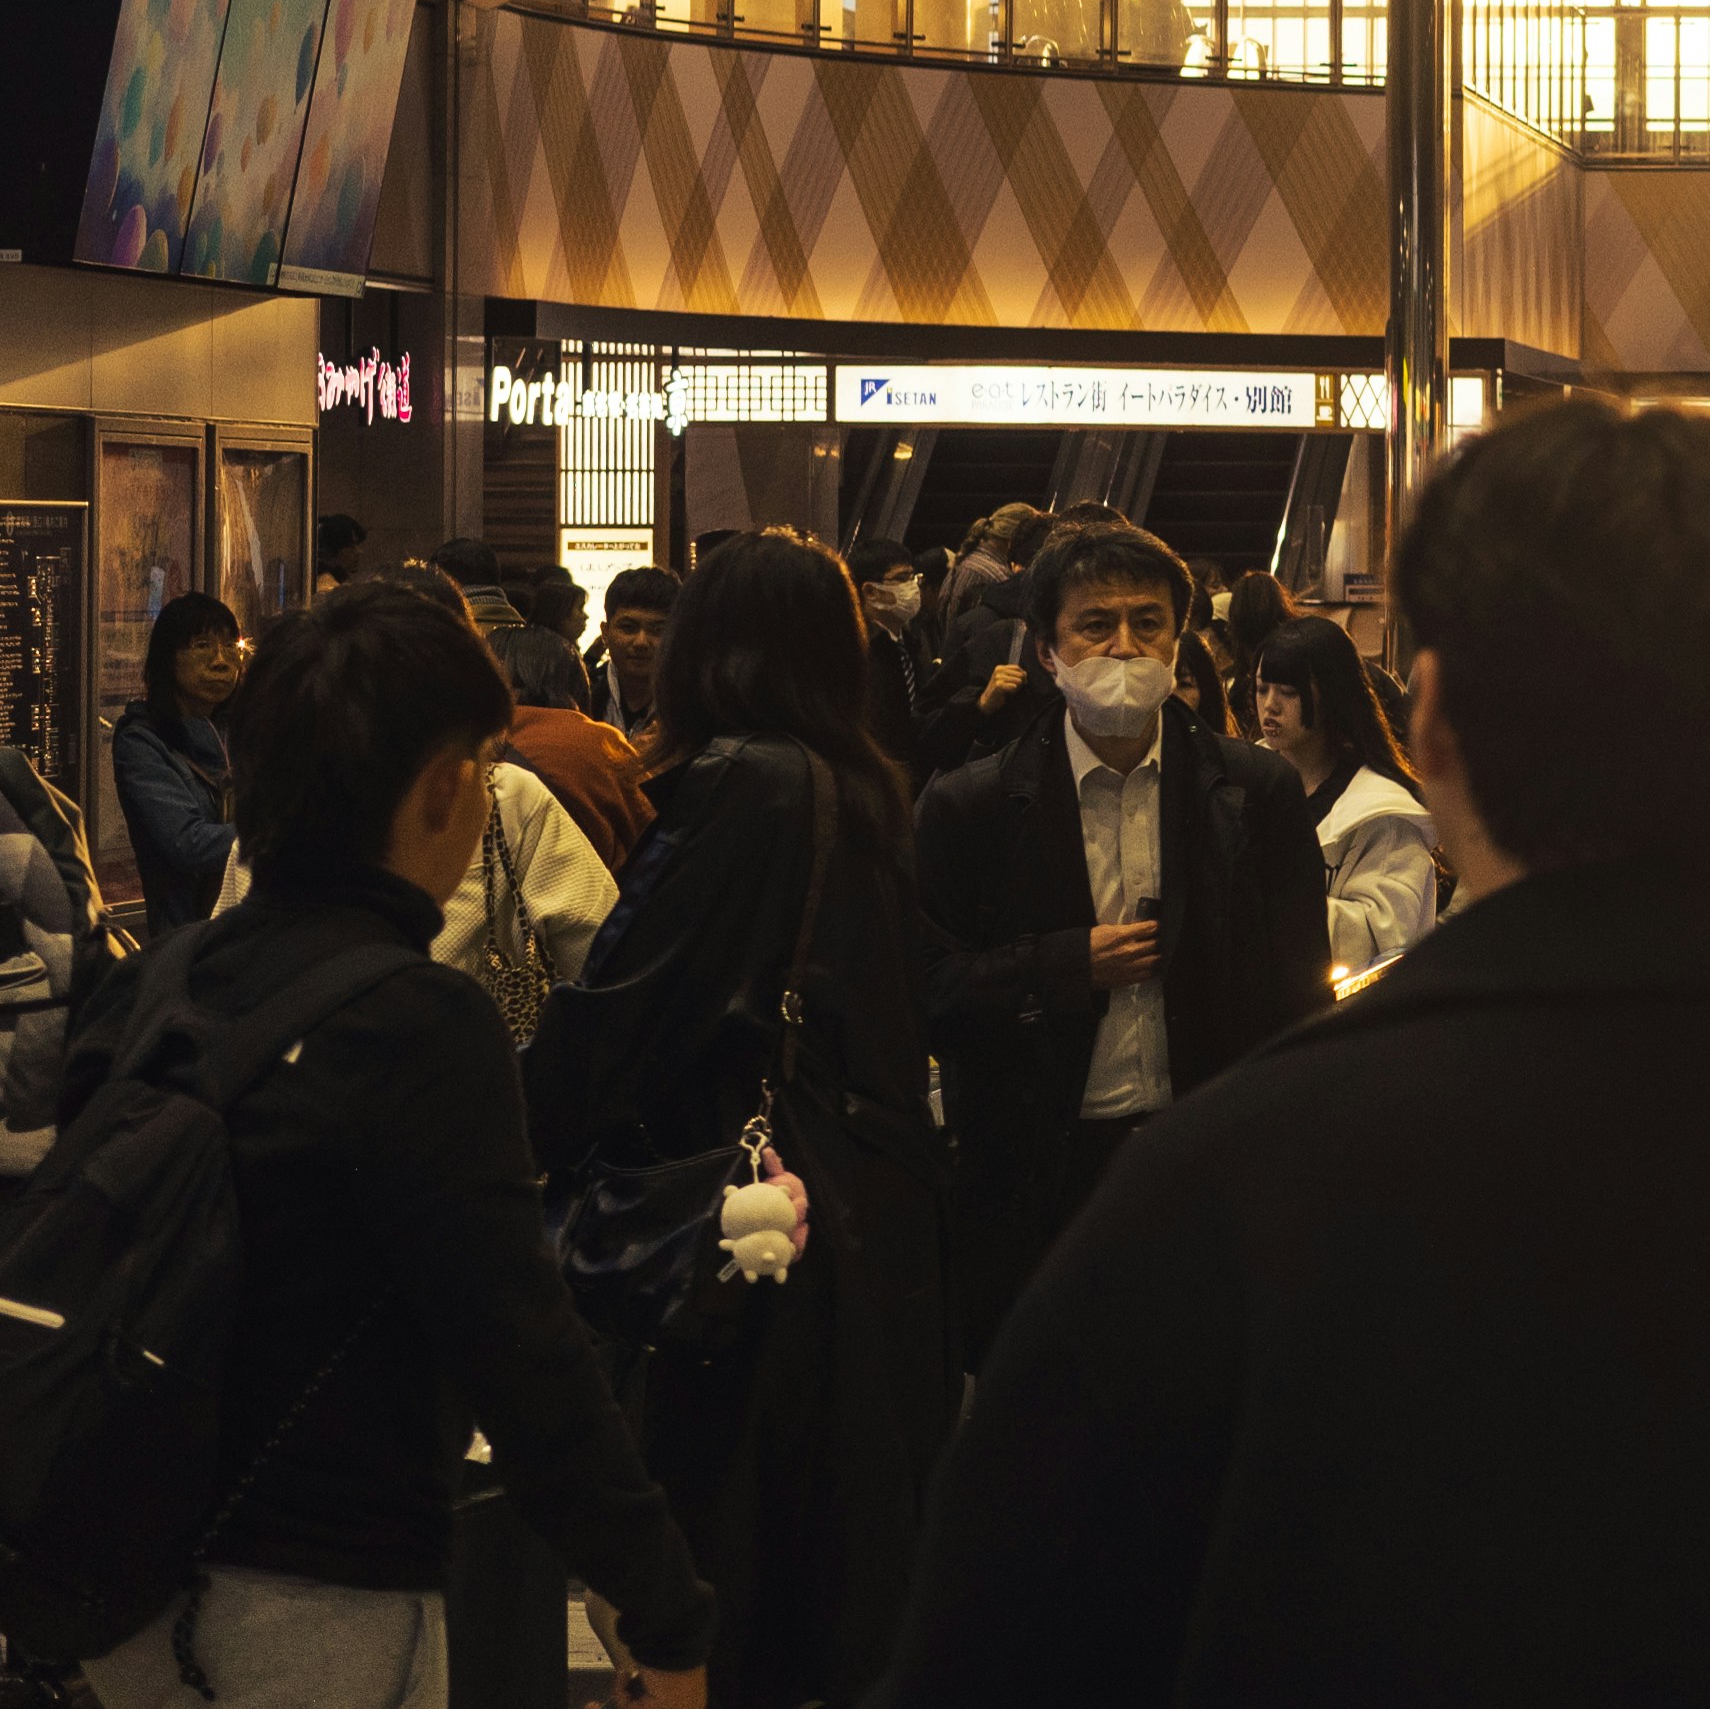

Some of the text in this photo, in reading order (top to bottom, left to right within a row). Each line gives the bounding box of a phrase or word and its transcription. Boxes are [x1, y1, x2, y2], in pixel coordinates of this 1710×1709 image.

[489, 365, 569, 426] Porta
[864, 381, 877, 396] JR
[1022, 380, 1106, 412] レストラン街
